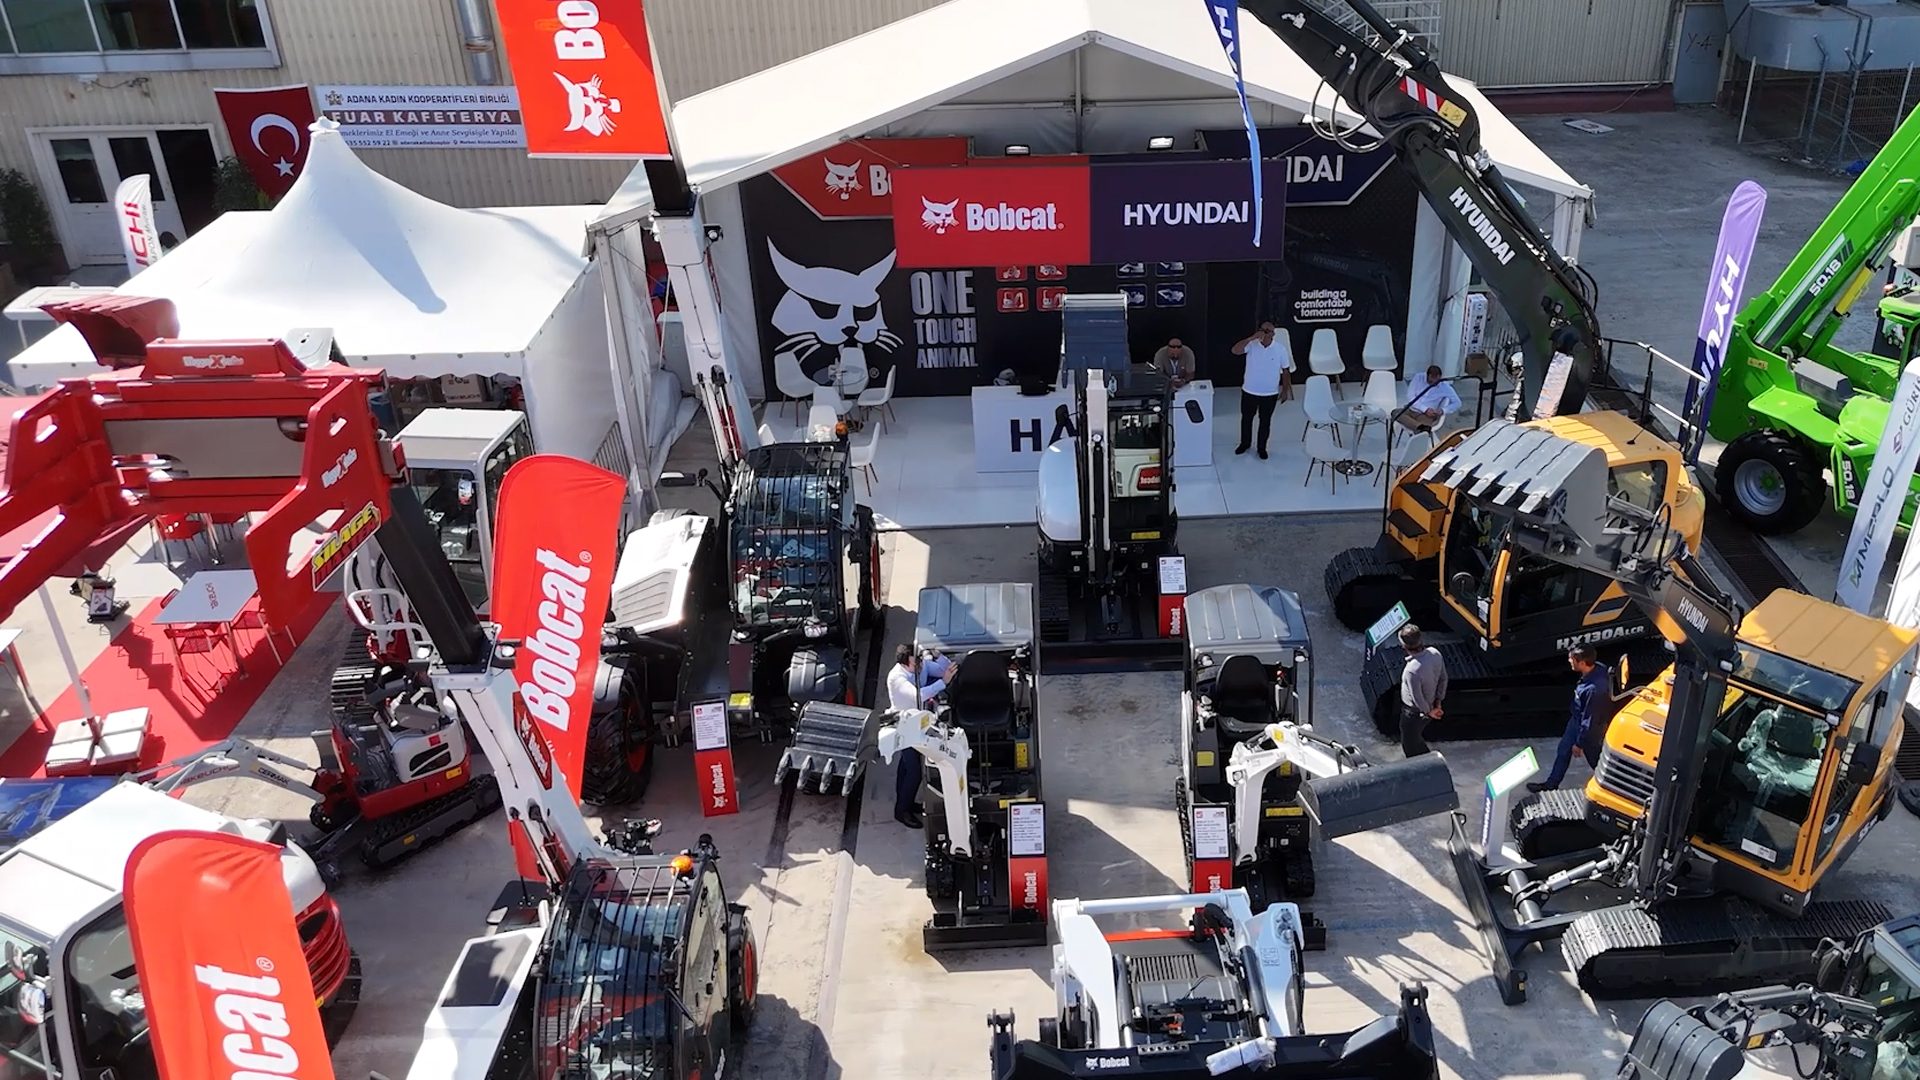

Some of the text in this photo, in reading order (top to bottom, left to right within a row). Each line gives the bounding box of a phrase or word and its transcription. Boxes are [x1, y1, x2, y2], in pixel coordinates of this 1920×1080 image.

[554, 0, 606, 59] Bo
[346, 93, 510, 104] ADANA KADIN KOOPERATİFLERİ BİRLİĞİ
[331, 110, 512, 123] FUAR KAFETERYA
[341, 129, 383, 137] meklerimiz
[385, 128, 394, 136] El
[395, 129, 419, 138] Emeği
[965, 202, 1057, 231] Bobcat
[1124, 201, 1249, 226] HYUNDAI
[1449, 186, 1516, 265] HYUNDAI
[910, 270, 976, 315] ONE
[1809, 259, 1842, 296] 50.18
[1294, 298, 1353, 309] comfortable
[1301, 289, 1347, 301] building a
[1301, 308, 1346, 317] tomorrow
[913, 317, 978, 345] TOUGH
[916, 346, 979, 369] ANIMAL
[1842, 460, 1856, 500] 50.18
[313, 505, 376, 570] SILAGE
[1677, 597, 1709, 634] HYUNDAI
[520, 548, 592, 732] Bobcat
[711, 763, 726, 795] Bobcat
[1024, 871, 1037, 904] Bobcat
[194, 964, 299, 1080] cat
[1099, 1056, 1130, 1069] Bobcat
